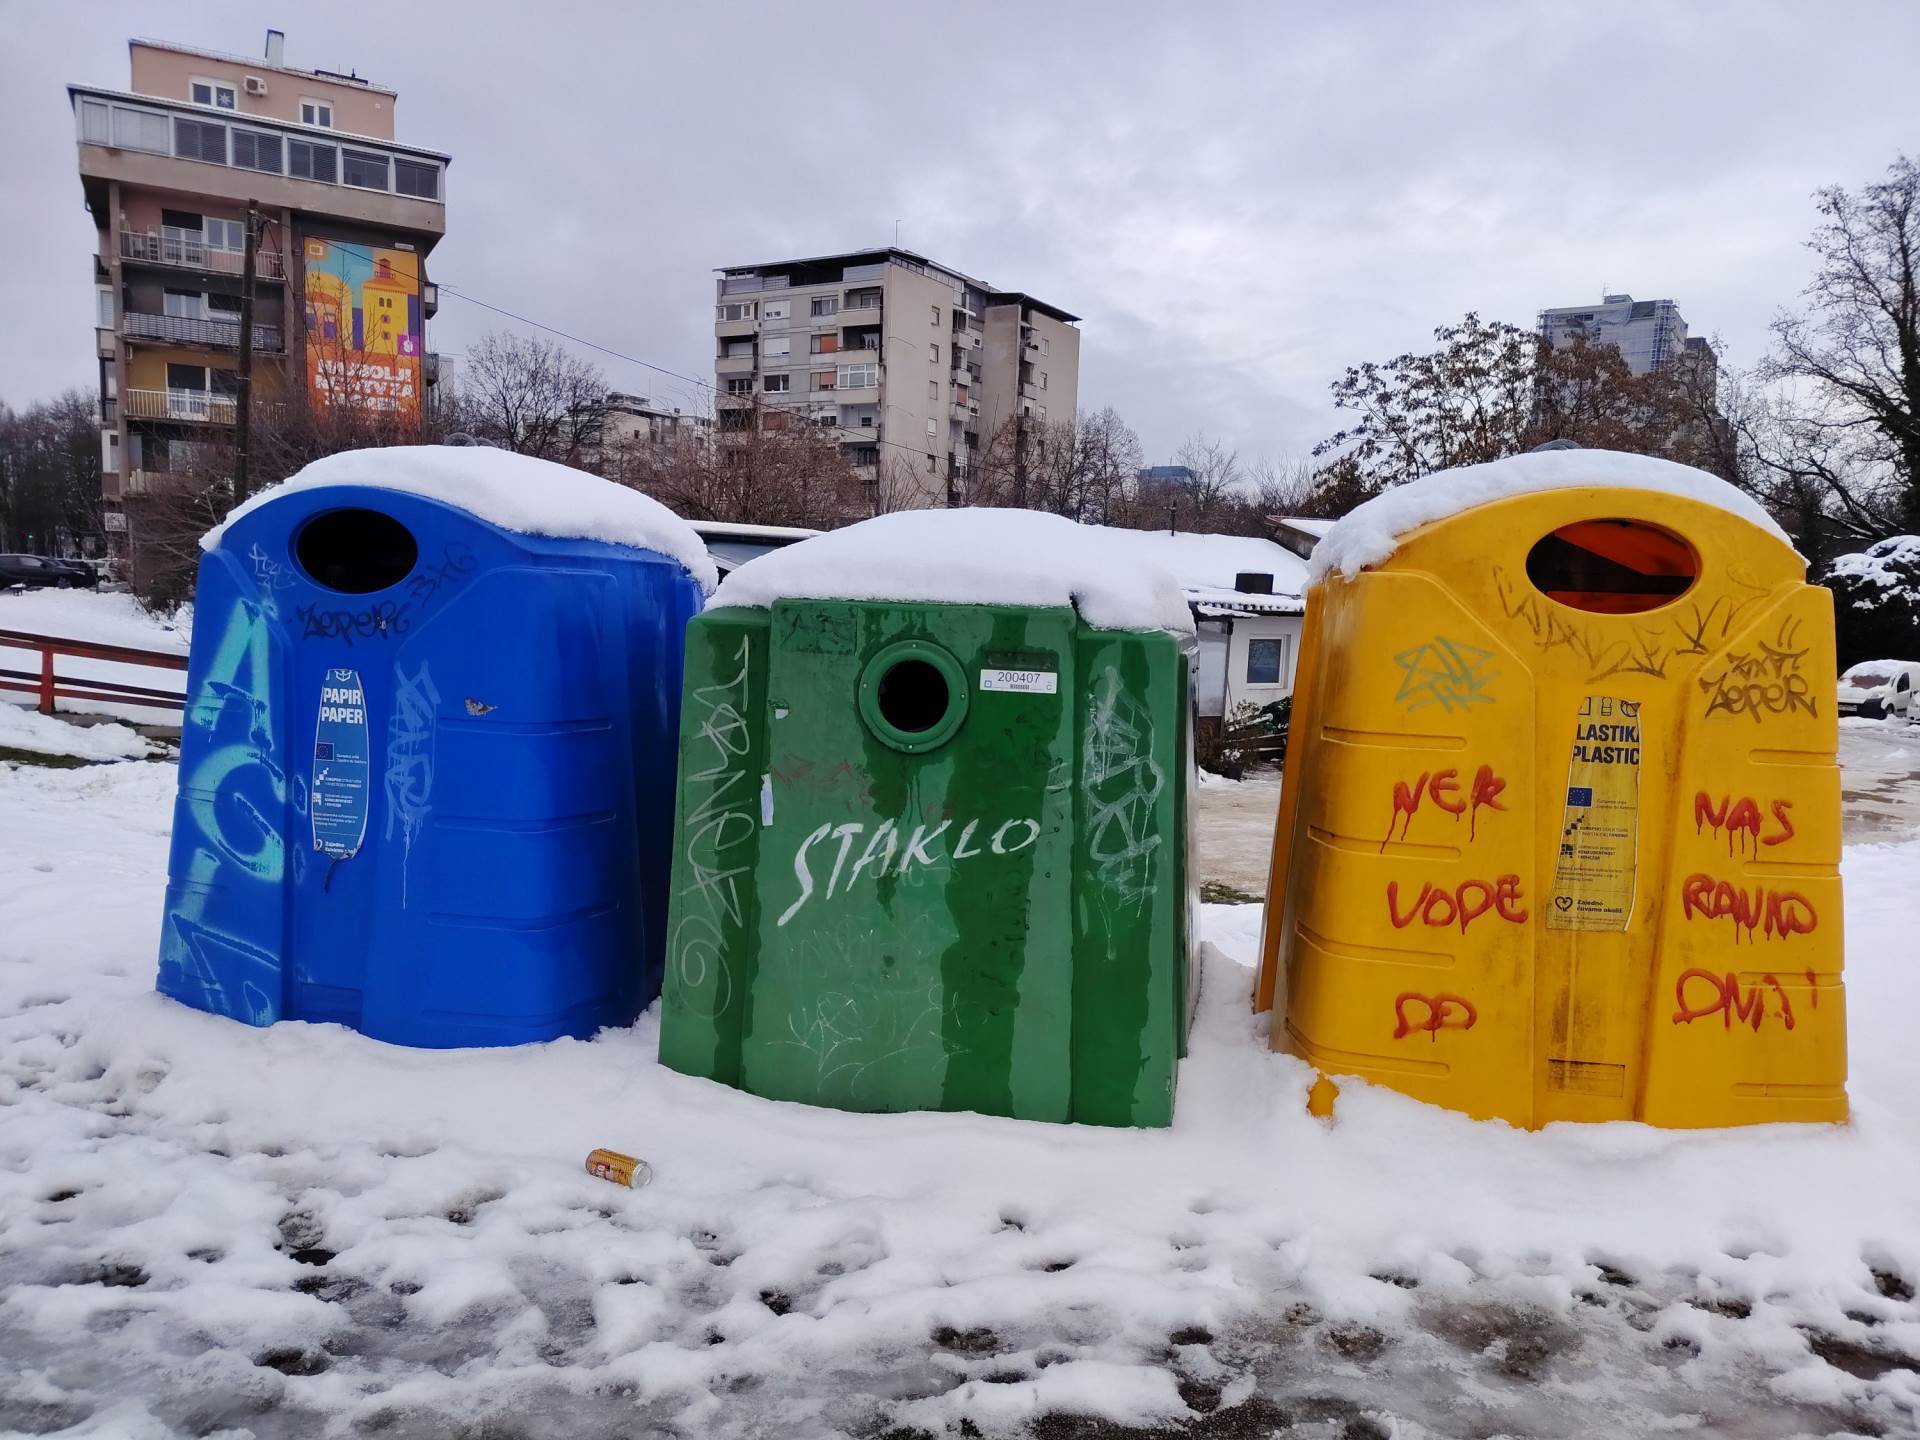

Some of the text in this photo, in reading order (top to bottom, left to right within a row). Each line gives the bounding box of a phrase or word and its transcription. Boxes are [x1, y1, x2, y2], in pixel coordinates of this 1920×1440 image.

[997, 671, 1041, 684] 200407
[323, 687, 361, 705] PAPIR
[321, 706, 363, 725] PAPER
[1576, 723, 1639, 743] LASTIK
[1571, 745, 1639, 766] PLASTIC
[777, 817, 1041, 927] STAKLO
